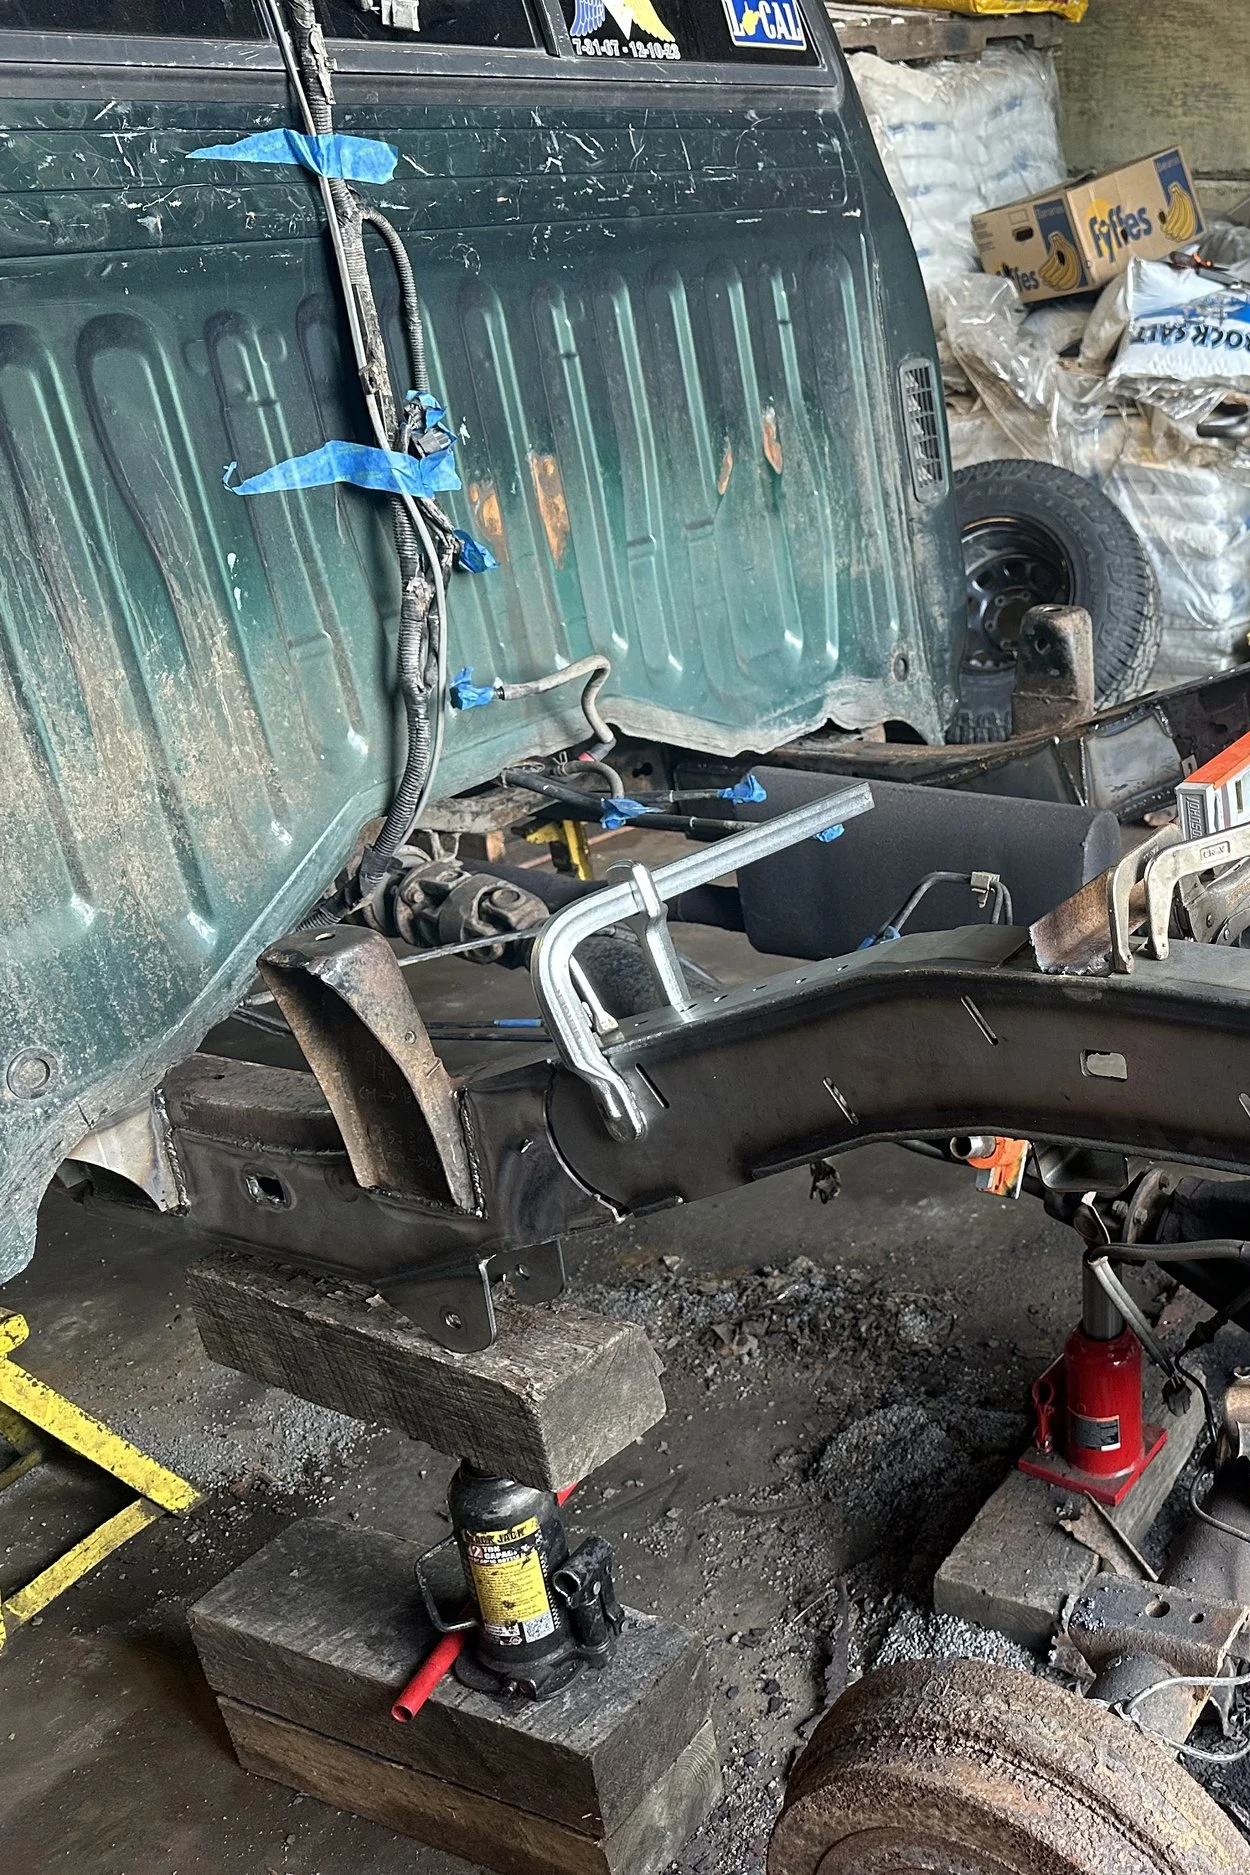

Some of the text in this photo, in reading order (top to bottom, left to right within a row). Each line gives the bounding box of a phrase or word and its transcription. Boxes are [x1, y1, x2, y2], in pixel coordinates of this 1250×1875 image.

[1089, 205, 1152, 263] fyffes
[1130, 323, 1190, 346] SALT
[1186, 797, 1203, 840] JOHNSO
[497, 1526, 526, 1543] JACK
